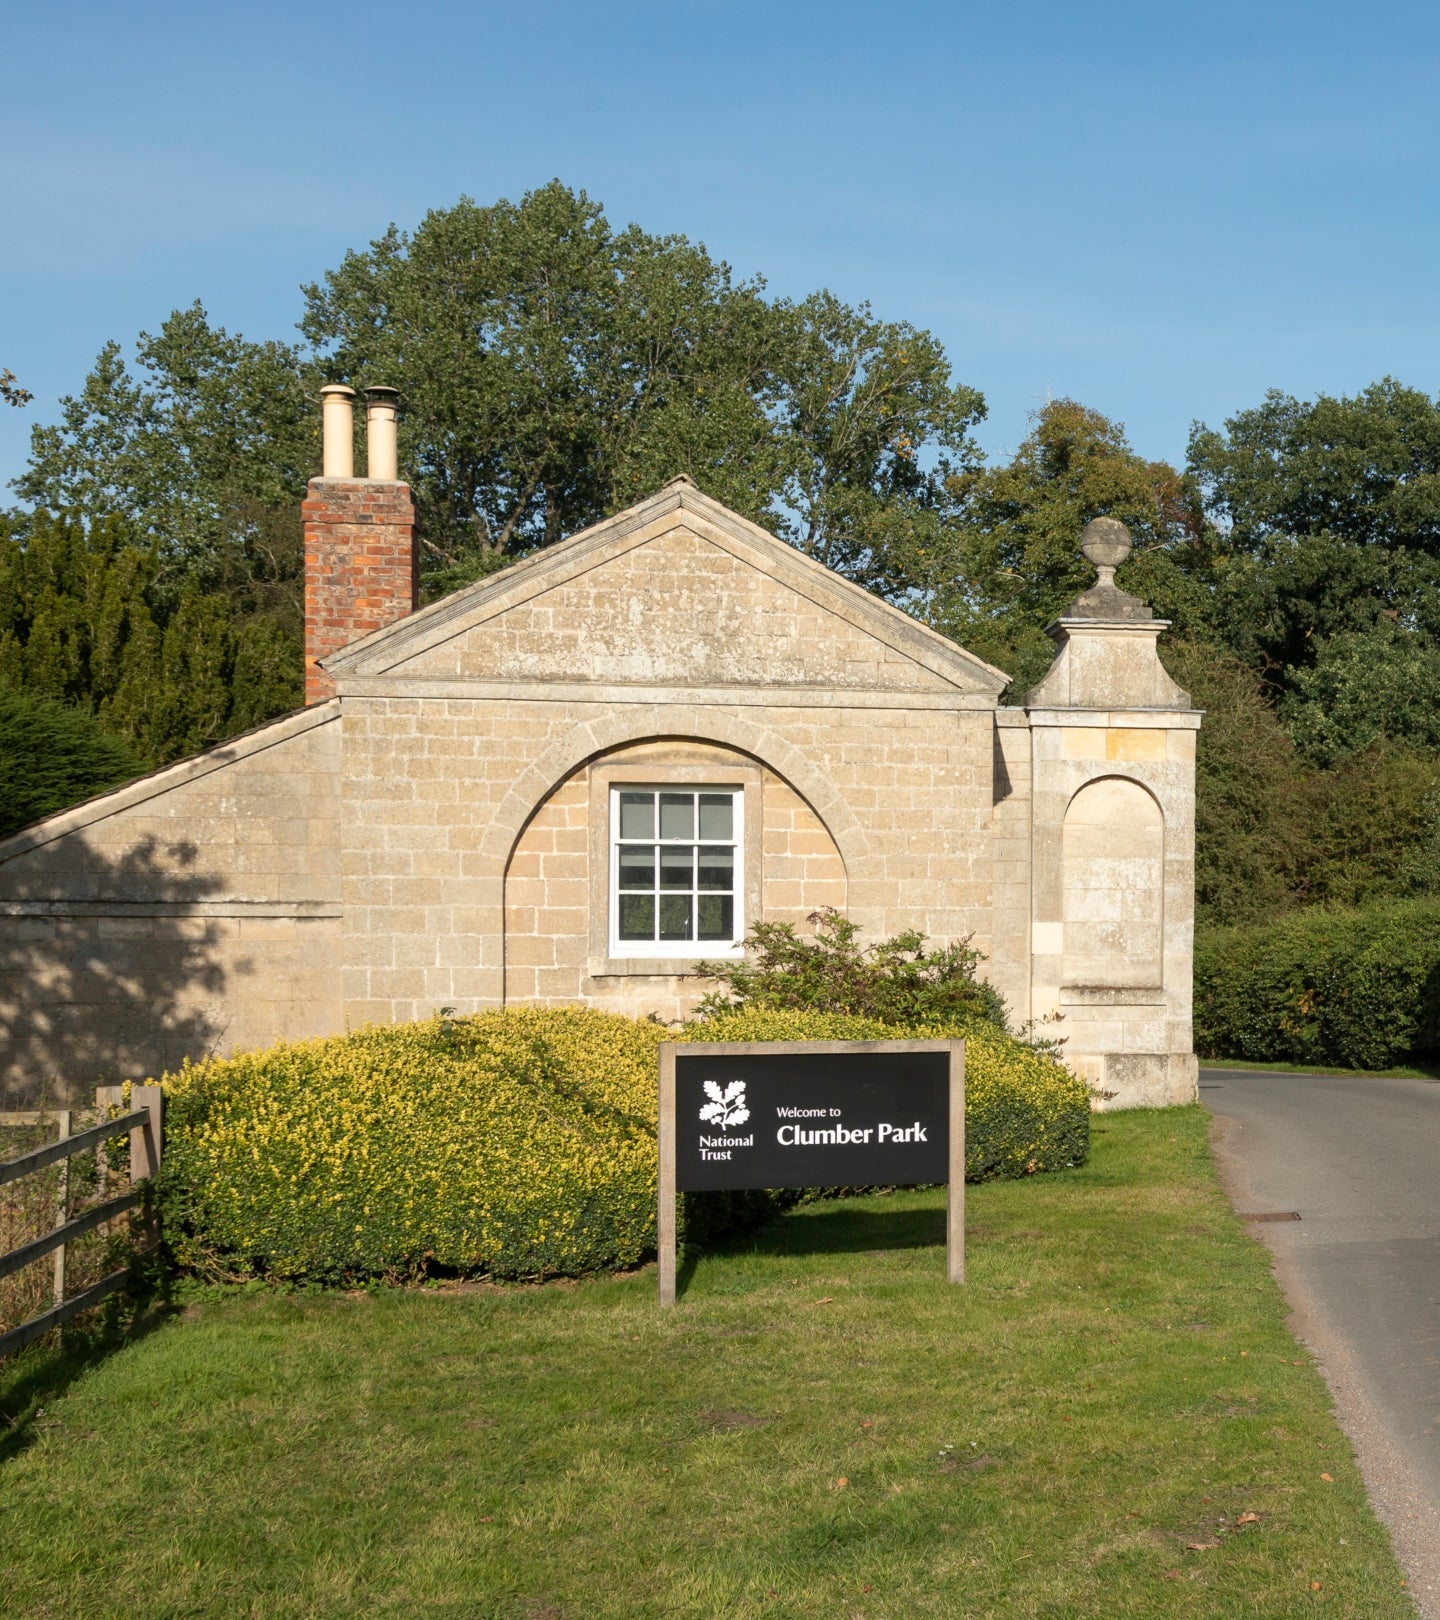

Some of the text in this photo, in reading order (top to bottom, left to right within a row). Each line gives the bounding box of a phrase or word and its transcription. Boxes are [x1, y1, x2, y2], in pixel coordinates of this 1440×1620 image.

[776, 1107, 841, 1118] Welcome to
[776, 1122, 928, 1145] Clumber Park
[699, 1134, 753, 1147] National
[699, 1149, 732, 1160] Trust
